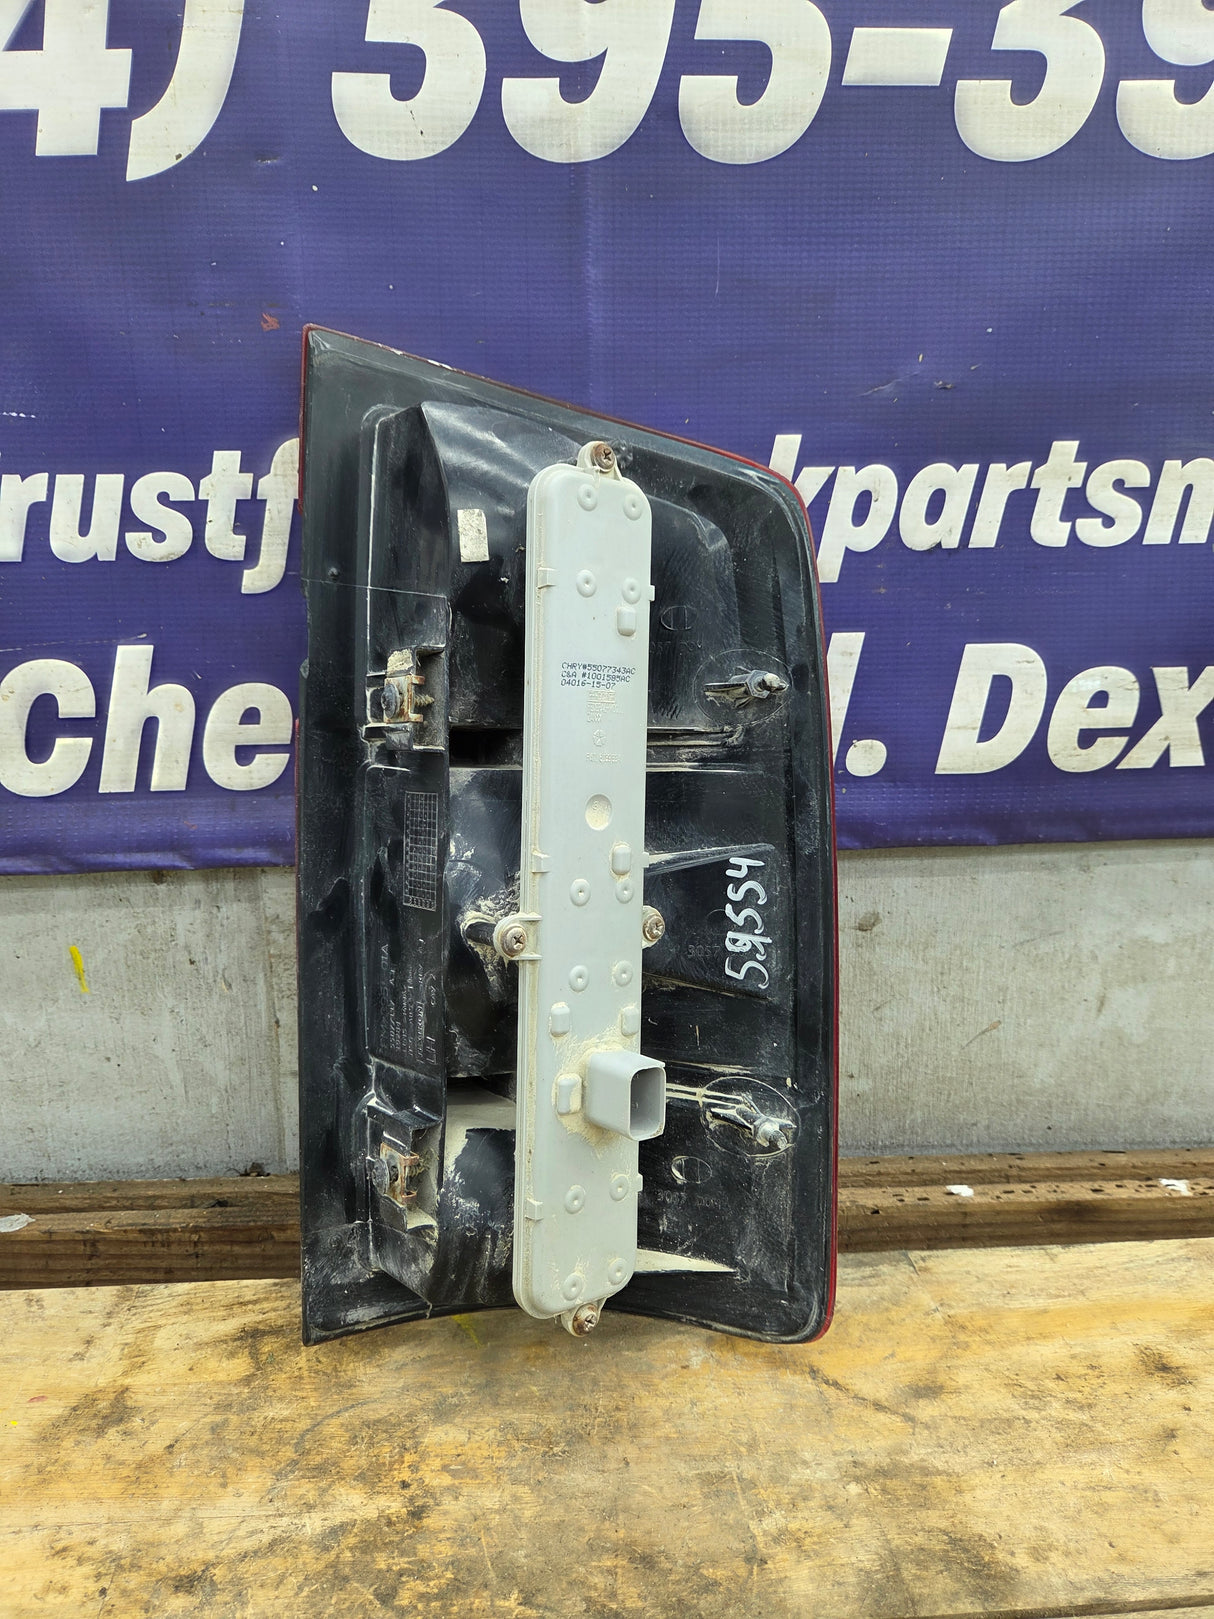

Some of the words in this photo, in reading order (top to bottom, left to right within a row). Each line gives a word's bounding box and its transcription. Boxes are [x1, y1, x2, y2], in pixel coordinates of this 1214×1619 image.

[561, 670, 577, 679] C&A
[560, 678, 616, 690] 04016-15-07
[0, 644, 292, 797] Che
[934, 643, 1214, 774] Dex
